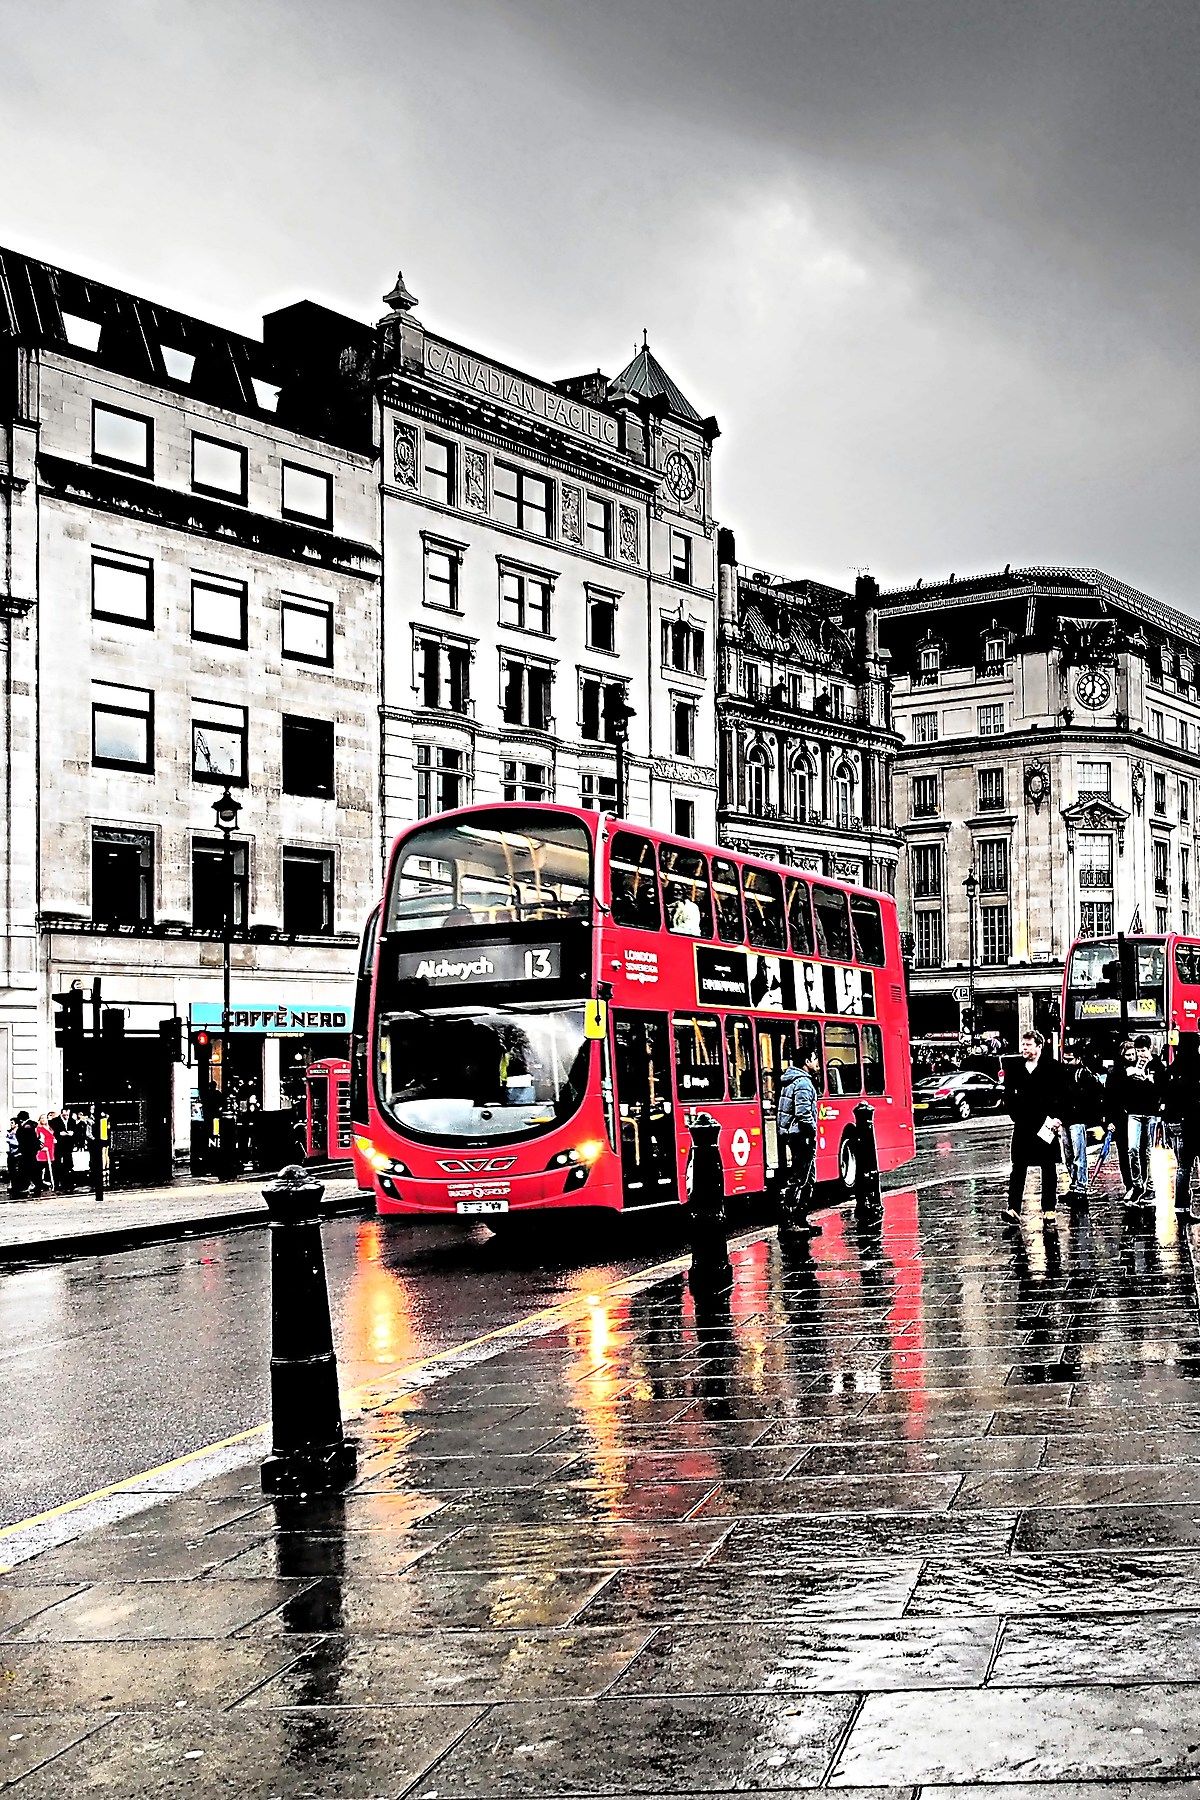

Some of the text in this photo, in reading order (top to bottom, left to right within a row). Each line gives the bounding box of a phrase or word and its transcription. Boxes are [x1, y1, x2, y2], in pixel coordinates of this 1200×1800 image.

[427, 344, 616, 444] CANADIAN PACIFIC
[415, 949, 552, 981] Aldwych 13
[290, 1011, 346, 1028] NERO
